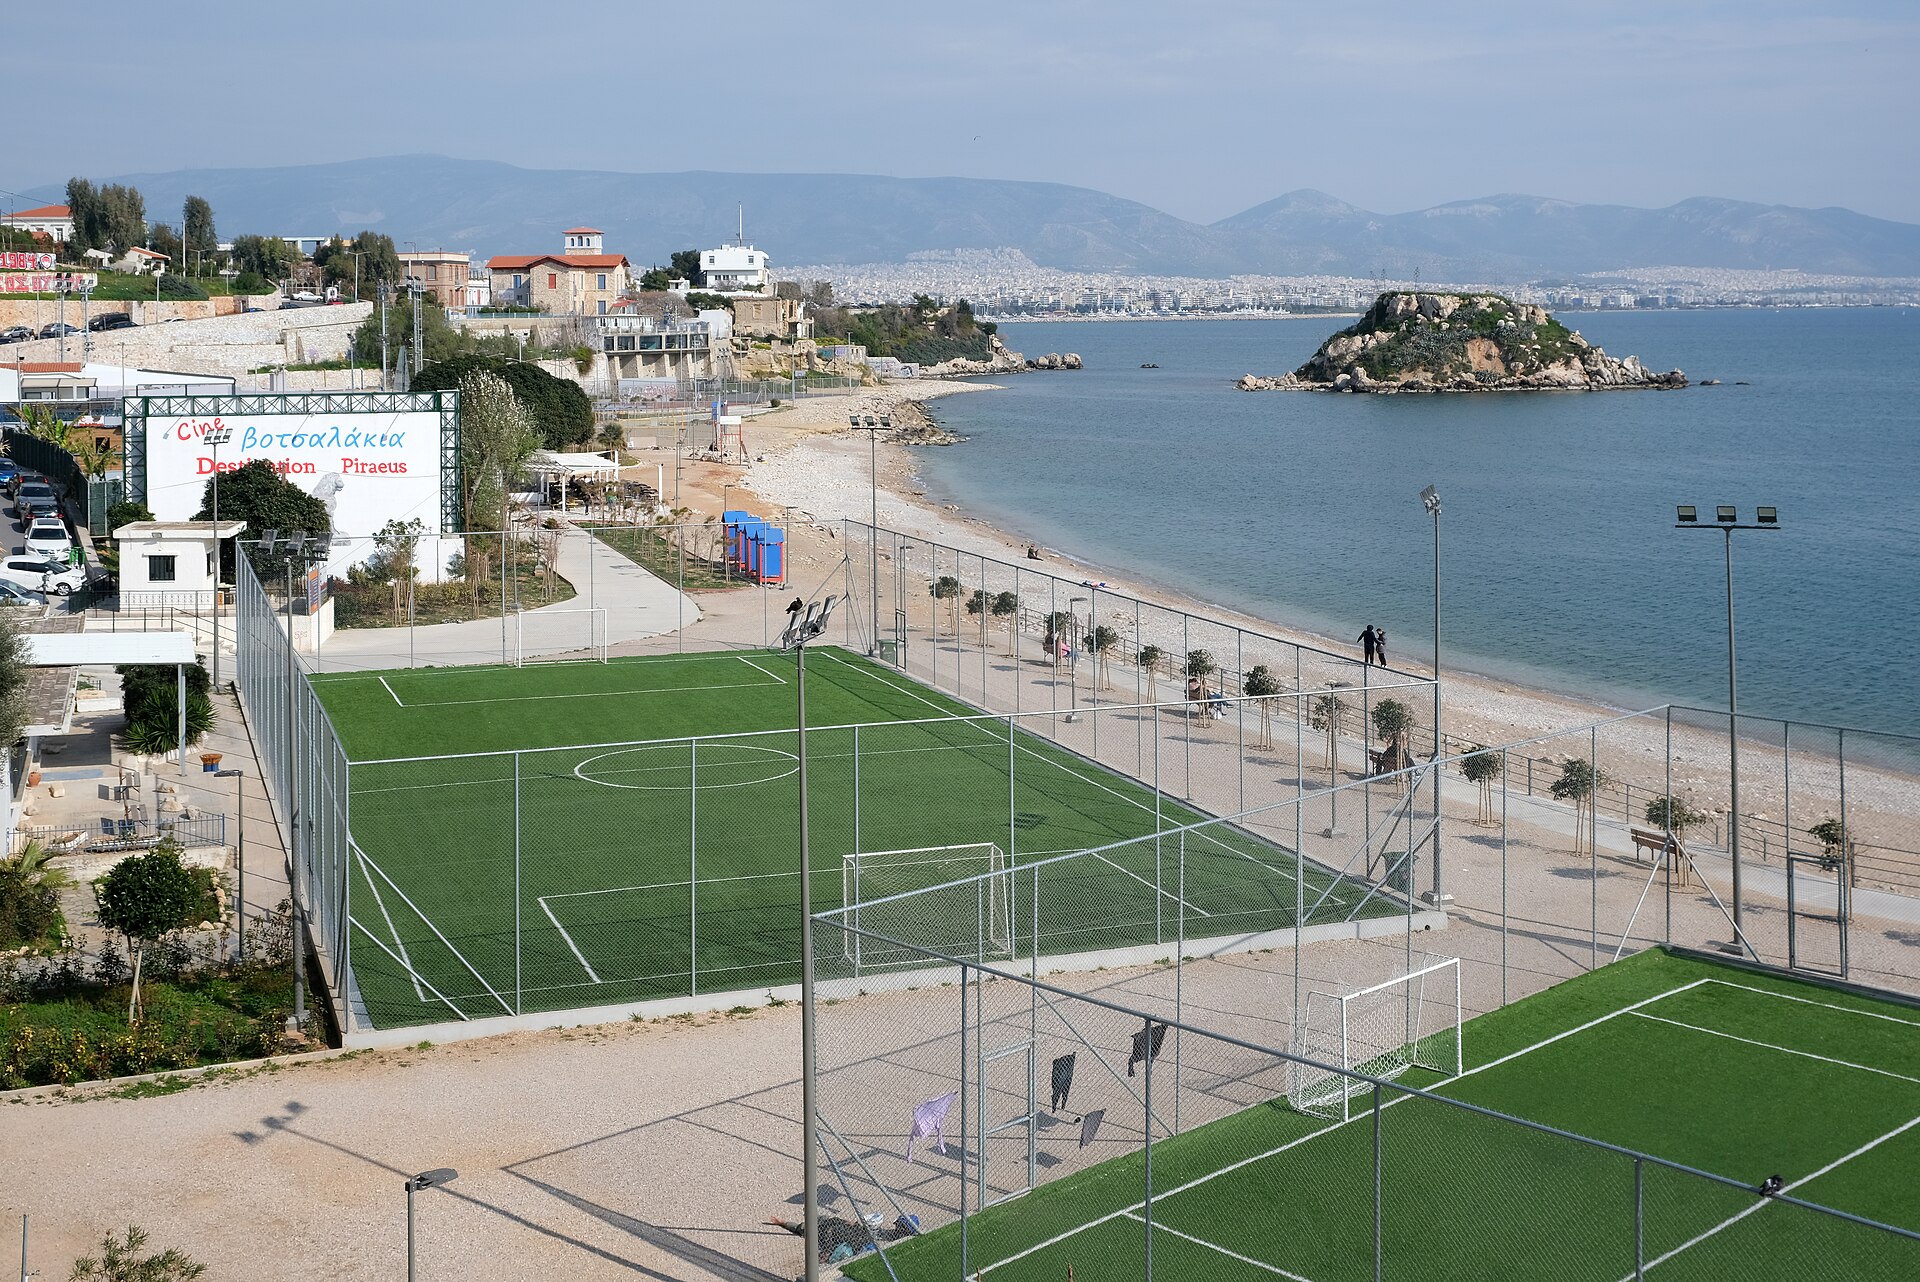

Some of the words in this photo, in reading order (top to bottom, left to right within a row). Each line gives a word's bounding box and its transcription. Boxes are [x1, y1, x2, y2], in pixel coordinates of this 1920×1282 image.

[0, 252, 37, 269] 1984
[177, 417, 225, 441] Cine
[241, 426, 406, 452] βοτσαλάκια
[196, 457, 316, 475] Destiation
[341, 457, 408, 474] Piraeus
